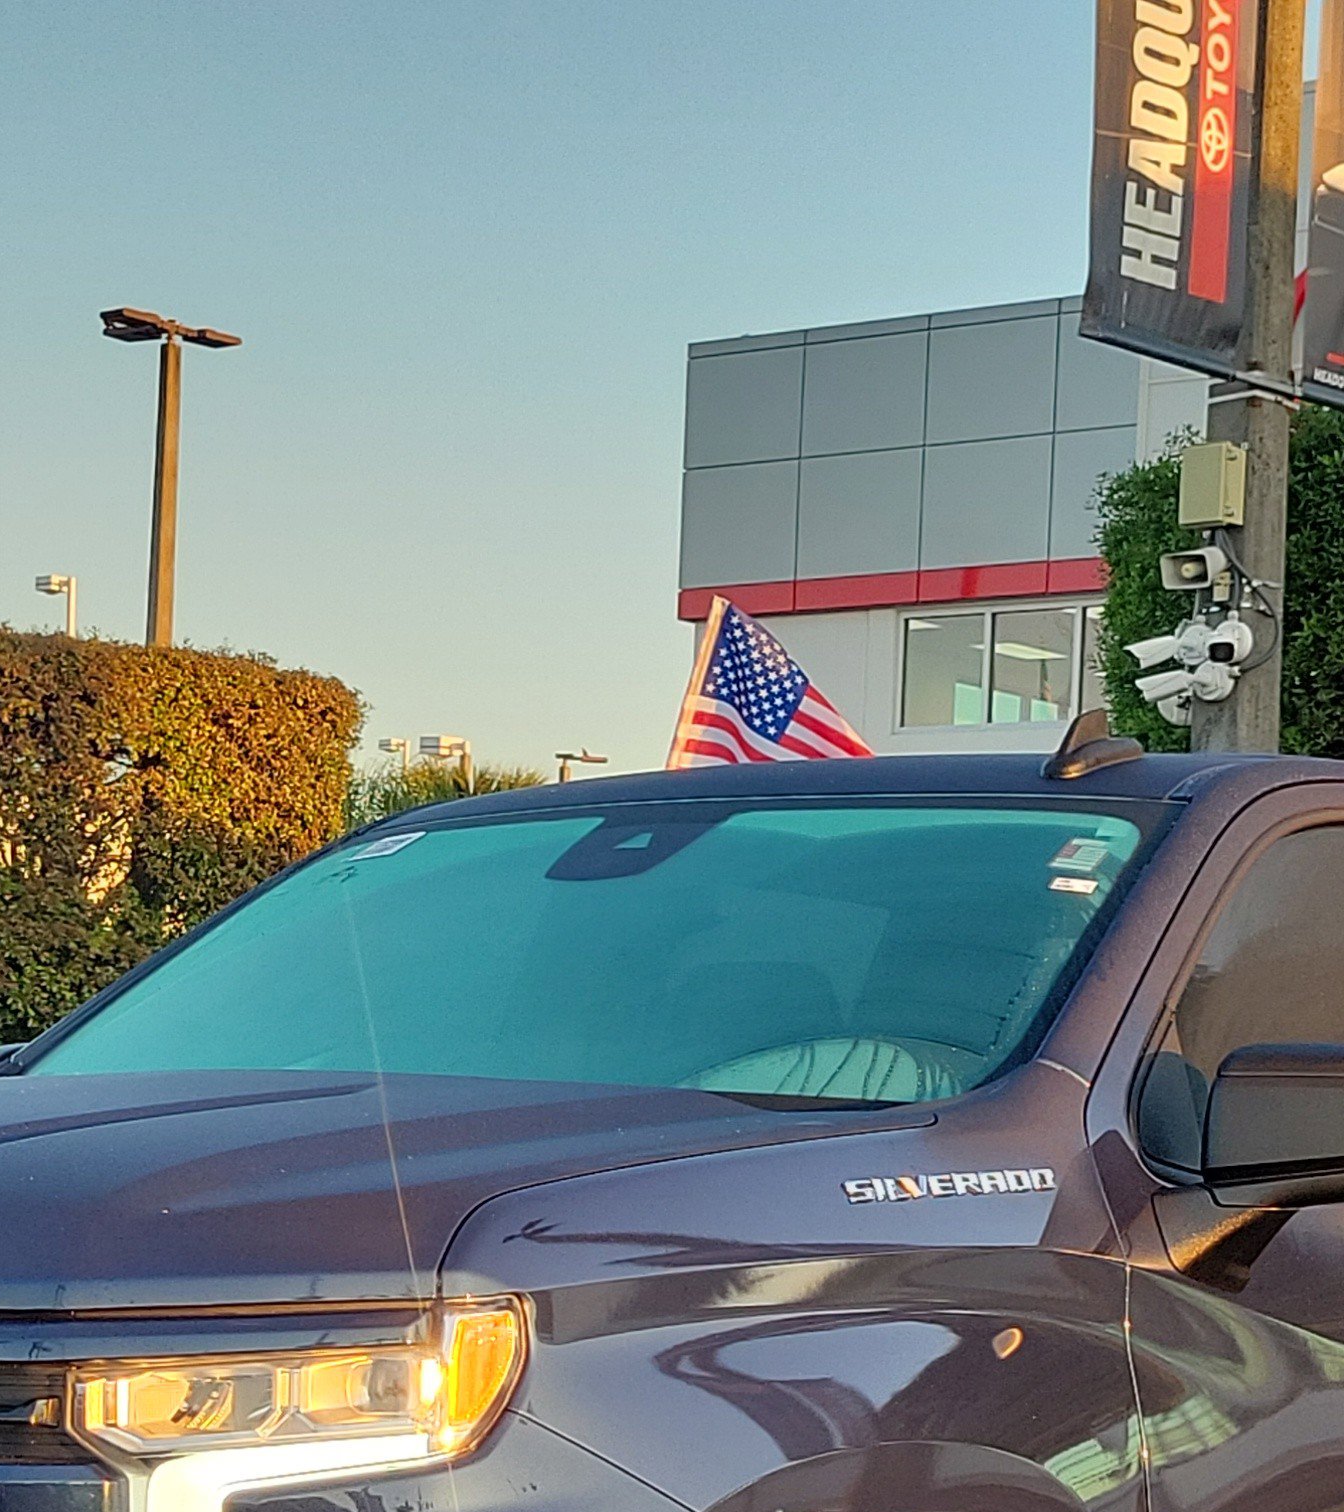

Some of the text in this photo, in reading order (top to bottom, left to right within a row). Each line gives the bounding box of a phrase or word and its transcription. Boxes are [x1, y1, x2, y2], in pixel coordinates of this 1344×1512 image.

[1206, 0, 1233, 99] TOY
[1120, 0, 1200, 290] HEADQU
[841, 1168, 1056, 1205] SILVERADO
